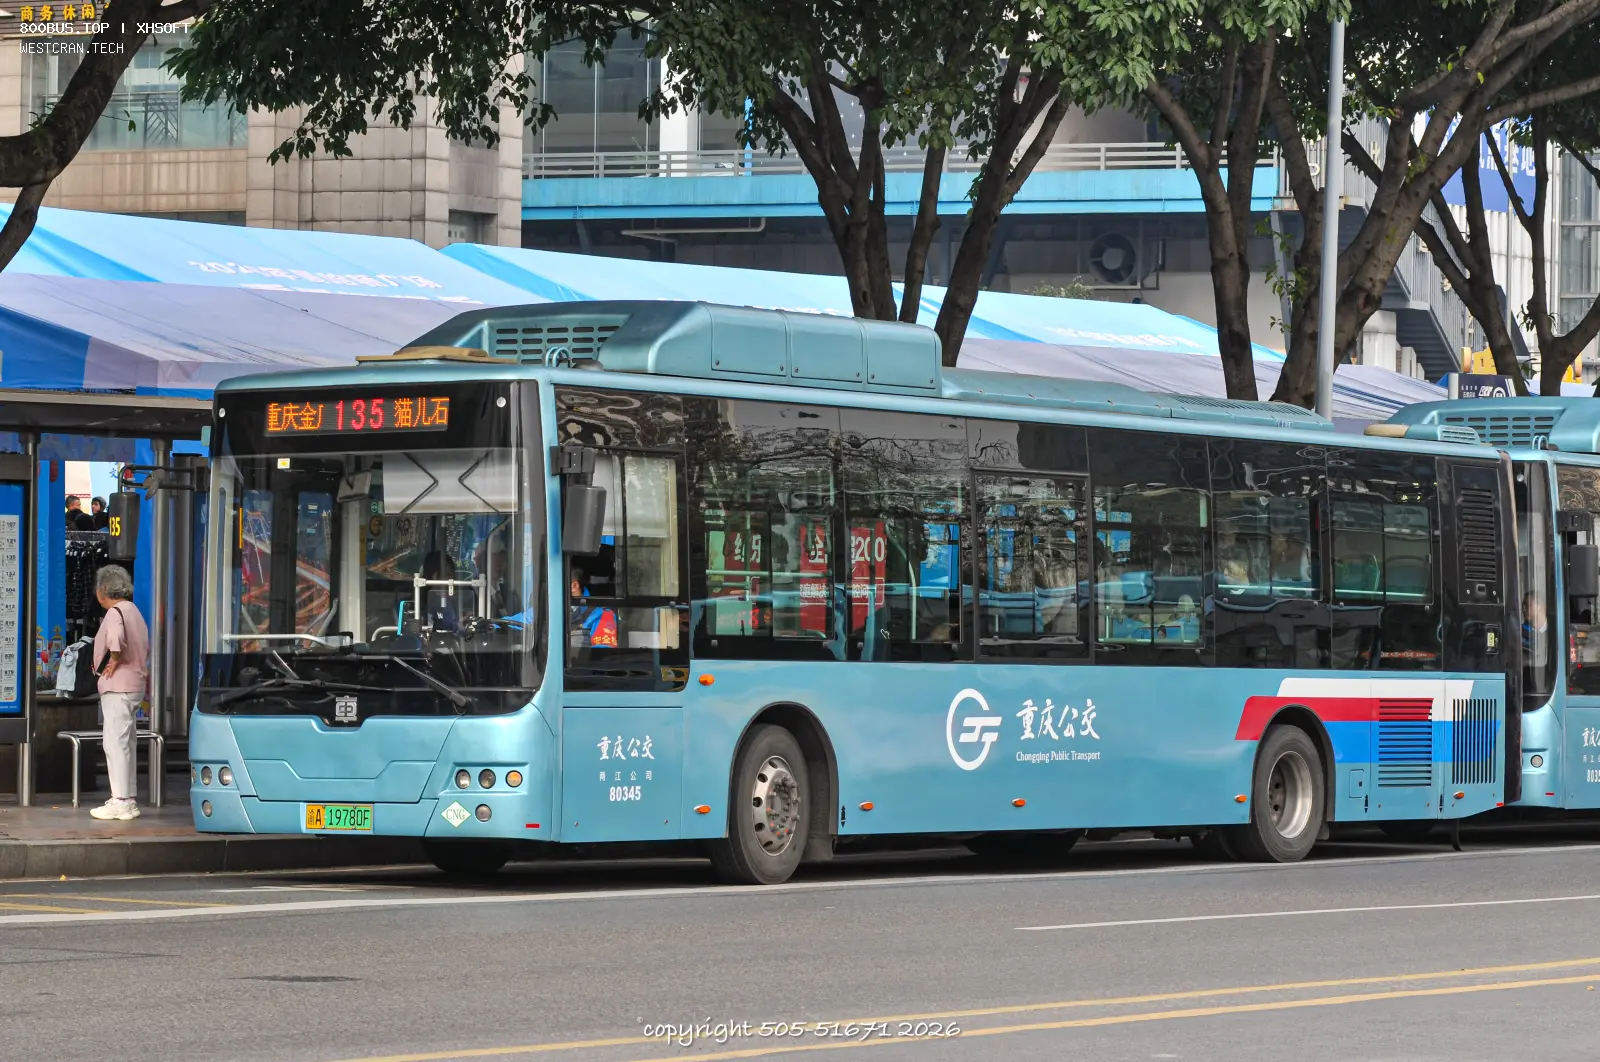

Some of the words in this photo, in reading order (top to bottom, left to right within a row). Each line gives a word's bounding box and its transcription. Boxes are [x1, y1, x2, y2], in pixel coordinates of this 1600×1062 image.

[20, 3, 109, 21] 商务休闲
[336, 398, 385, 431] 135
[394, 397, 450, 428] 猫儿石
[1016, 698, 1100, 740] 重庆公交
[597, 735, 655, 760] 重庆公交
[1016, 751, 1050, 763] Chongqing
[1051, 751, 1070, 761] Public
[1071, 751, 1101, 762] Transport
[609, 785, 642, 801] 80345
[328, 809, 370, 826] 19780F
[446, 808, 466, 820] CNG
